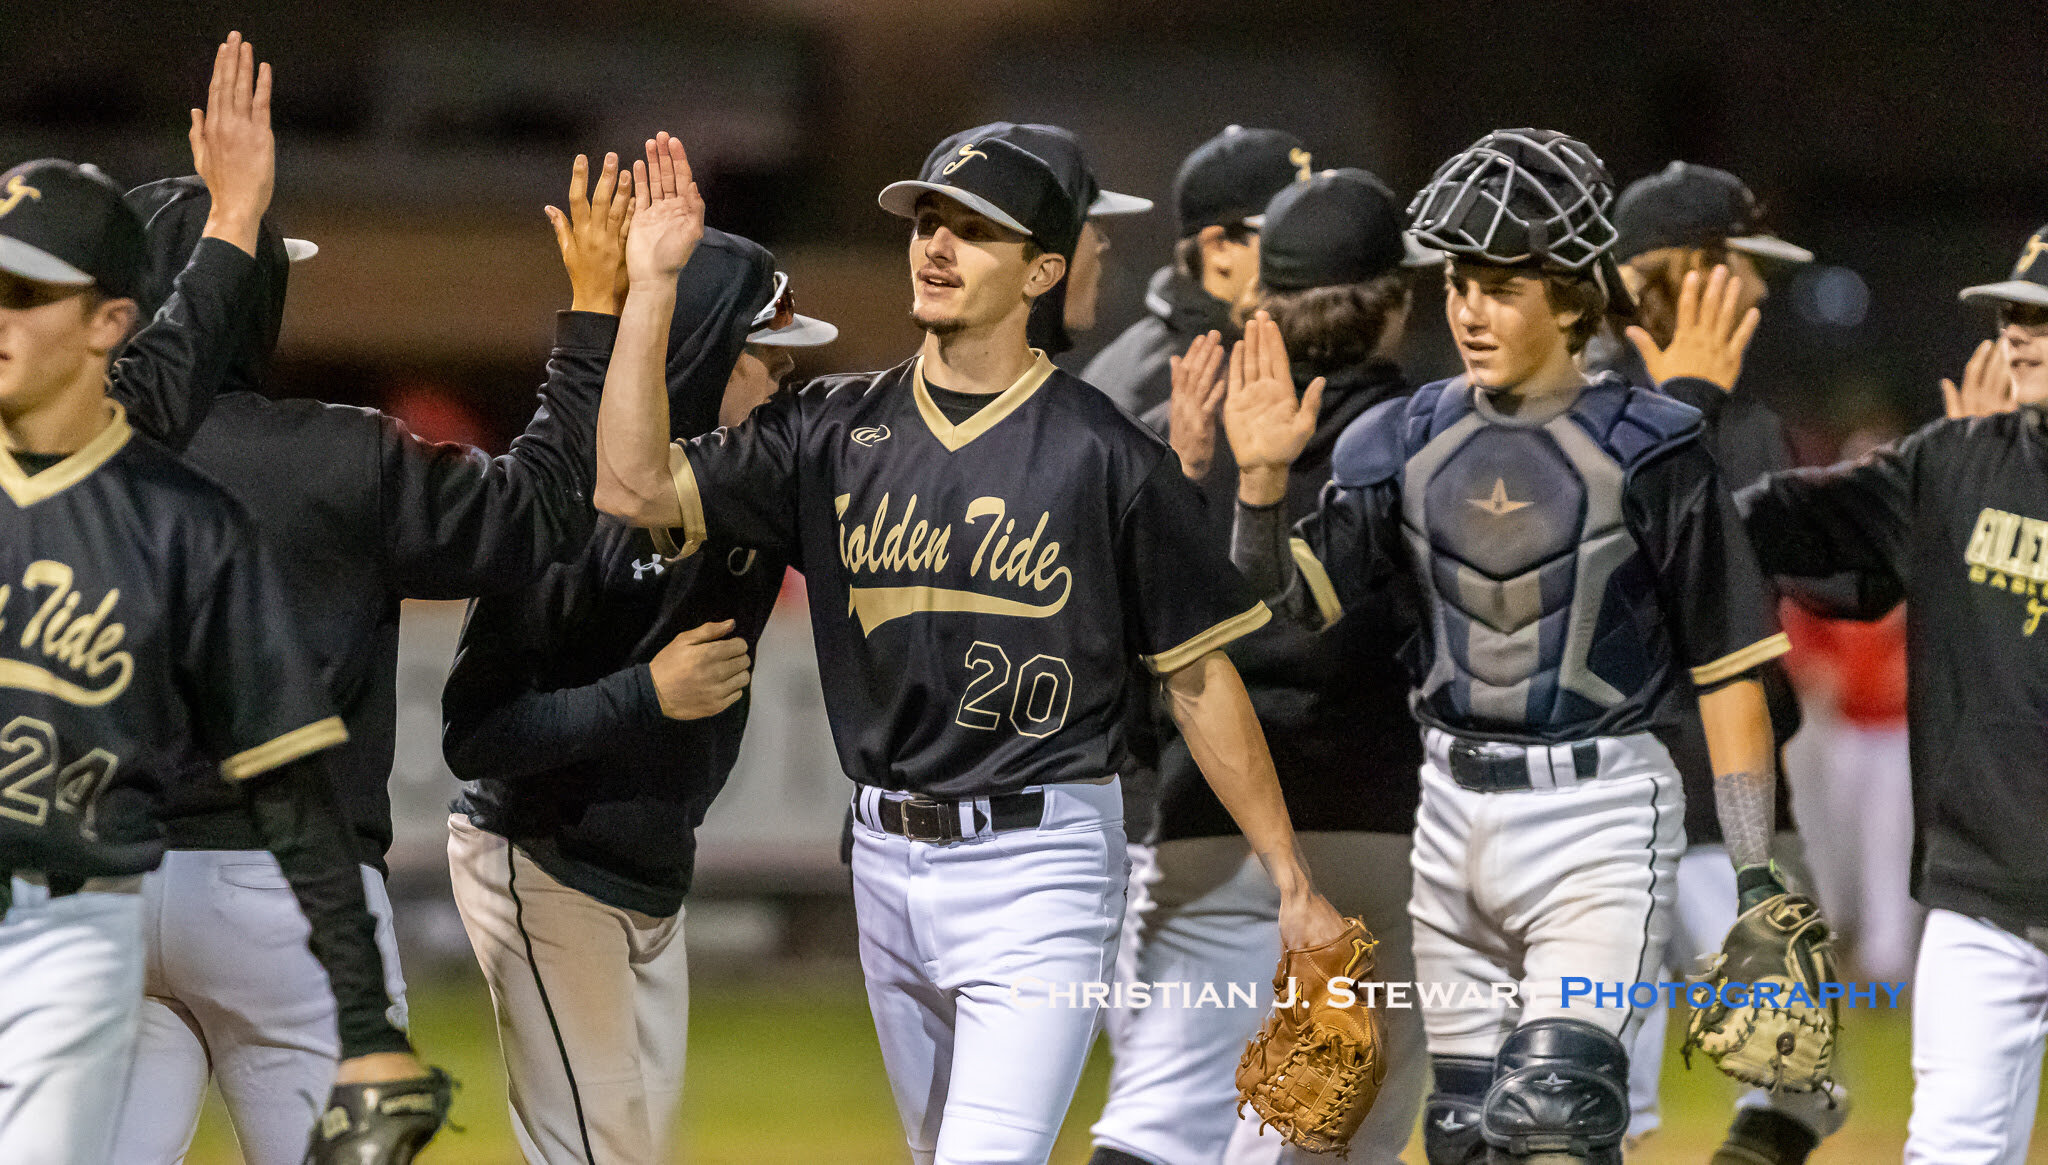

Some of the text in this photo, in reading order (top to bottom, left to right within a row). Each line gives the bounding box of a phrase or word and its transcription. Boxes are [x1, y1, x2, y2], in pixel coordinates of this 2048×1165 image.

[964, 496, 1070, 592] Tide
[21, 559, 133, 677] Tide
[955, 640, 1073, 739] 20
[0, 715, 119, 842] 24
